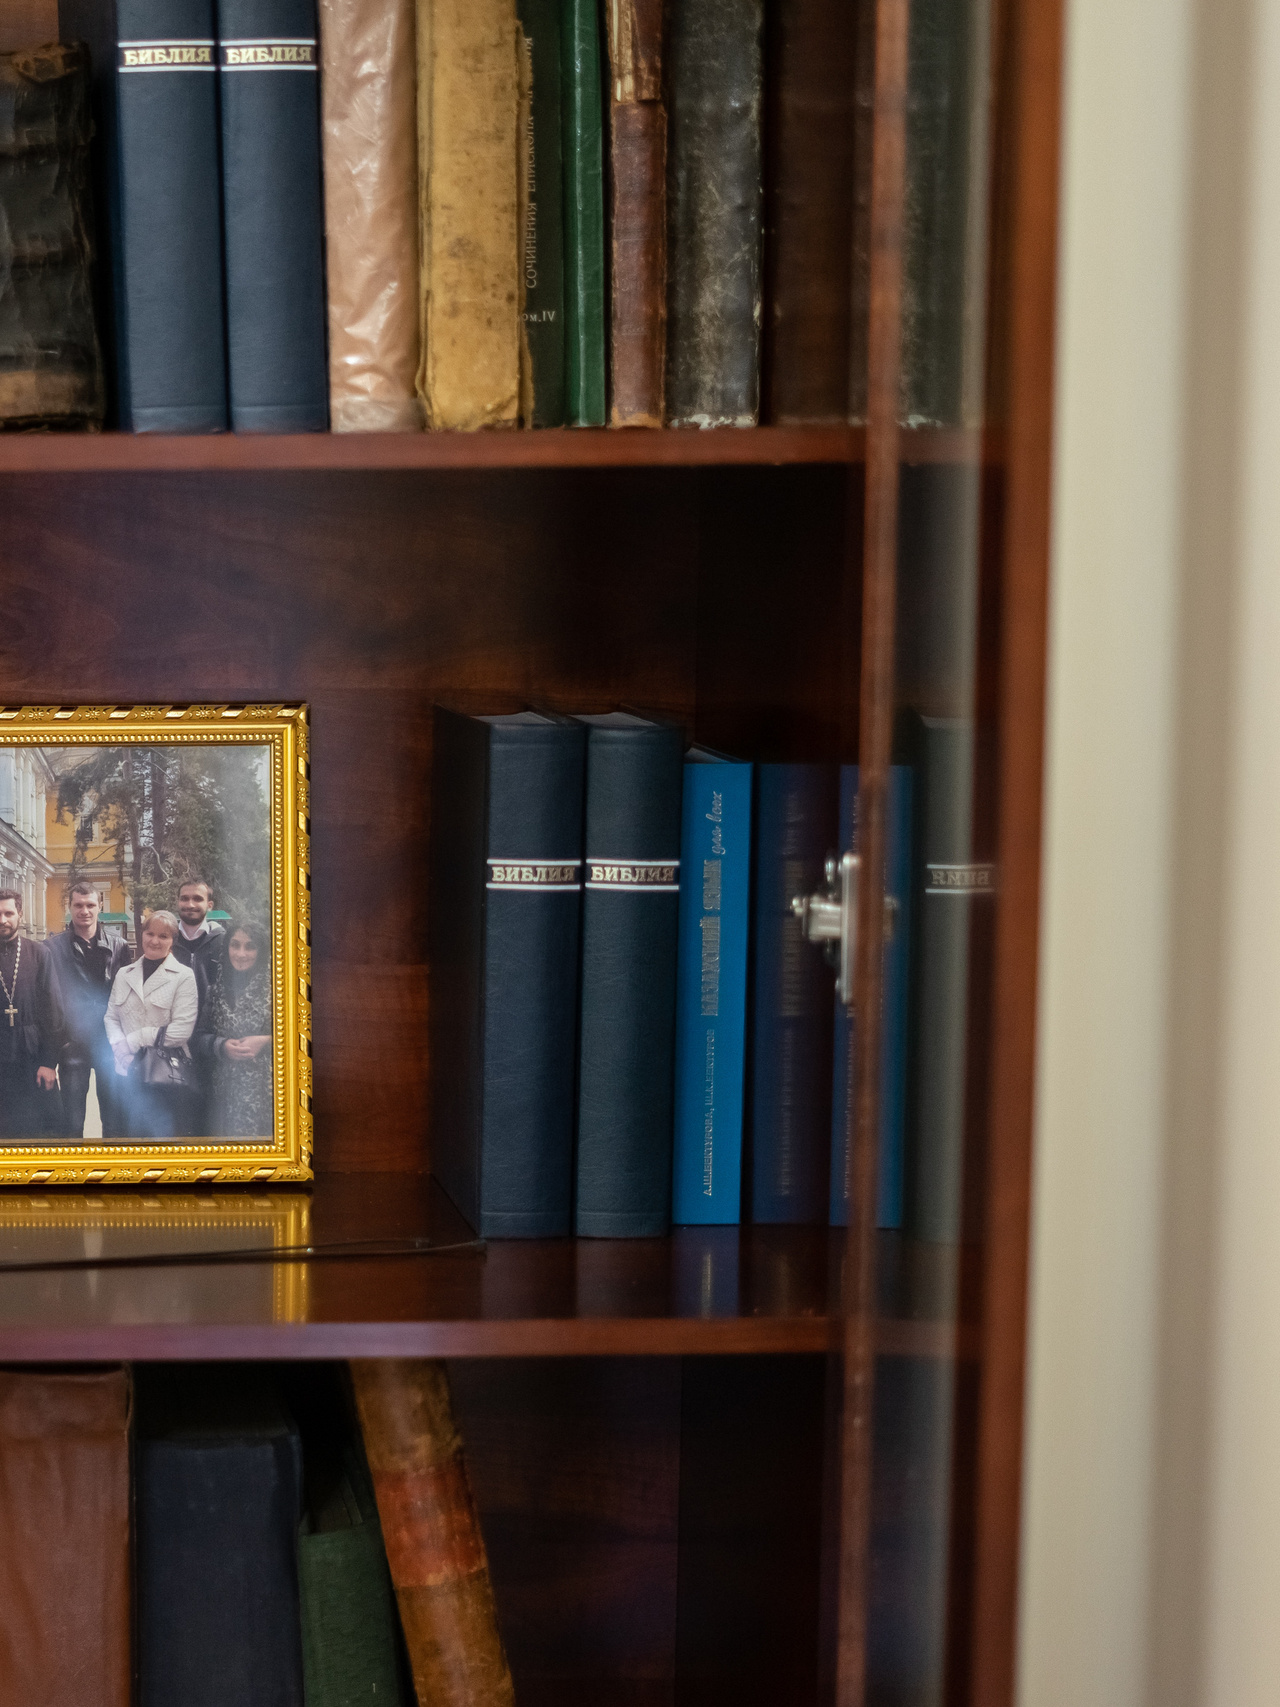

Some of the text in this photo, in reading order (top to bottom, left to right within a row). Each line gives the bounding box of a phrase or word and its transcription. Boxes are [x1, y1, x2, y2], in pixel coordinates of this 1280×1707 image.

[124, 47, 211, 66] БИБЛИЯ
[226, 46, 312, 64] БИБЛИЯ
[525, 202, 538, 289] СОЧИНЕНИЯ
[491, 866, 576, 883] БИБЛИЯ
[589, 866, 675, 883] БИБЛИЯ
[702, 859, 722, 911] ЯЗЫК
[699, 916, 722, 1016] КАЗАХСКИЙ
